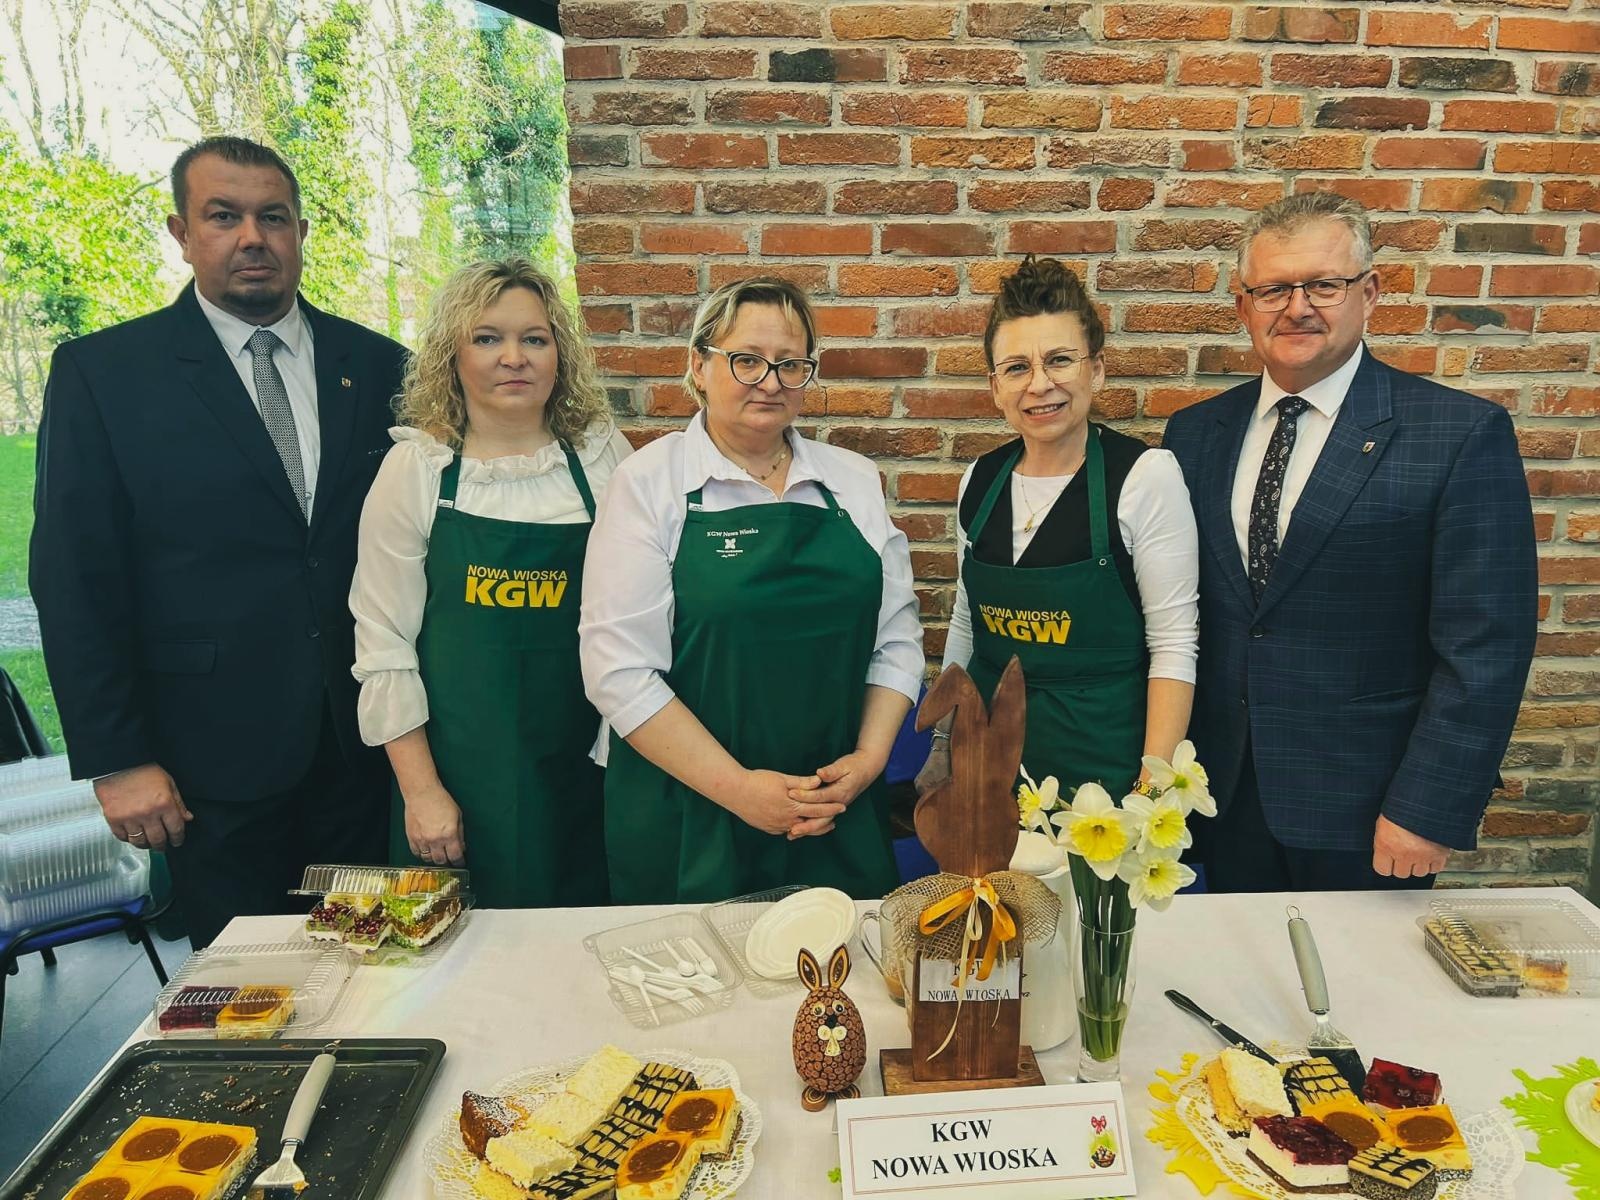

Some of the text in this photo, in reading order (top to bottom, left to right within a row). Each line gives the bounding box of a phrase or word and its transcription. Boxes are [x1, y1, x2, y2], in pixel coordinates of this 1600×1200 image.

[467, 564, 568, 580] NOWA WIOSKA
[465, 576, 567, 608] KGW
[979, 604, 1070, 621] NOWA WIOSKA
[982, 613, 1071, 645] KGW
[928, 988, 1011, 1001] NOWA WIOSKA
[930, 1119, 992, 1143] KGW
[872, 1146, 1058, 1180] NOWA WIOSKA
